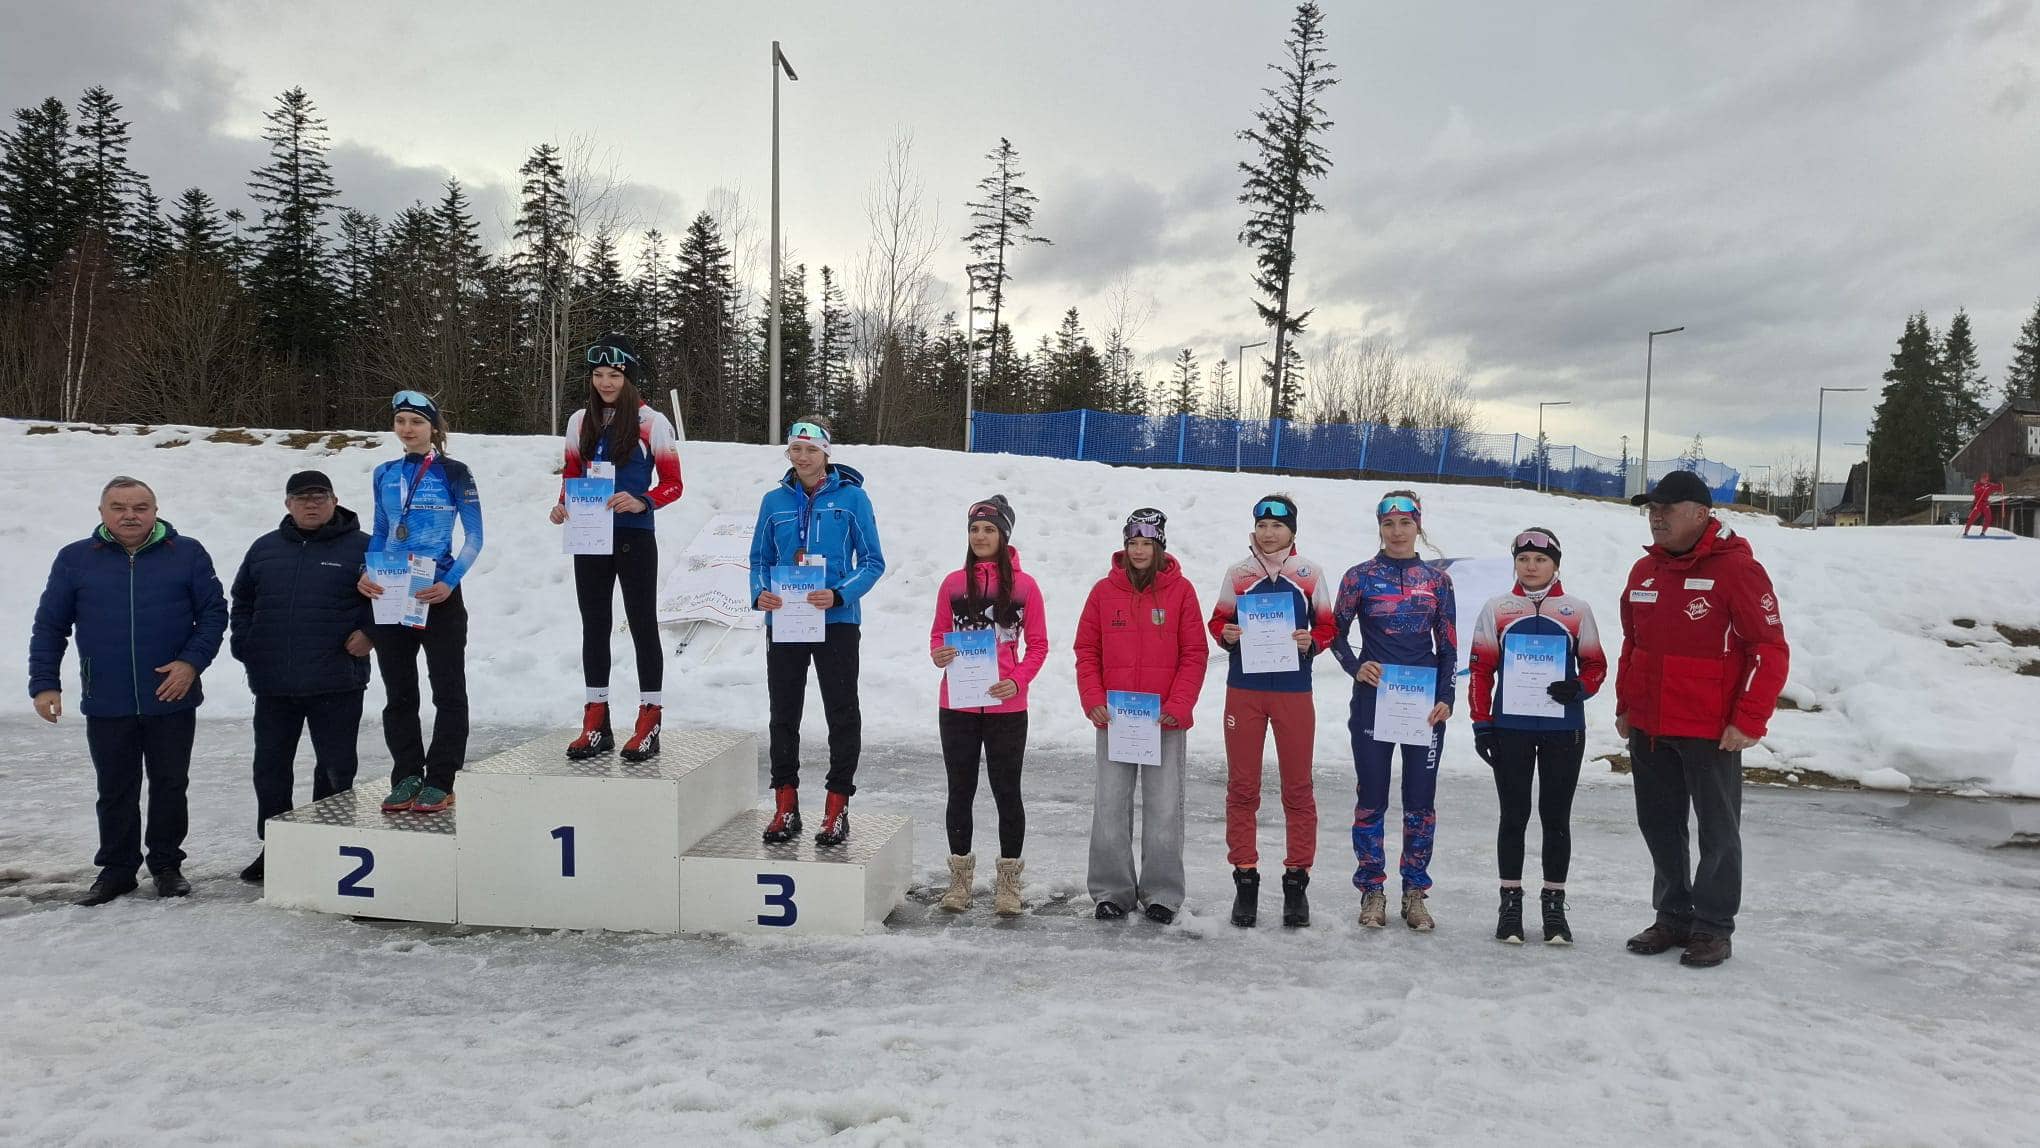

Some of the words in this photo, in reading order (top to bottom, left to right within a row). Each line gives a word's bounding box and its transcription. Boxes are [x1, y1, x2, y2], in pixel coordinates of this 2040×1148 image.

[781, 583, 815, 591] DYPLOM
[1249, 611, 1284, 620] DYPLOM
[955, 648, 987, 657] DYPLOM
[1516, 653, 1554, 662] DYPLOM
[1388, 683, 1425, 693] DYPLOM
[1117, 708, 1150, 717] DYPLOM
[1426, 732, 1440, 769] LIDER
[550, 825, 576, 878] 1
[337, 846, 375, 898] 2
[756, 874, 798, 927] 3
